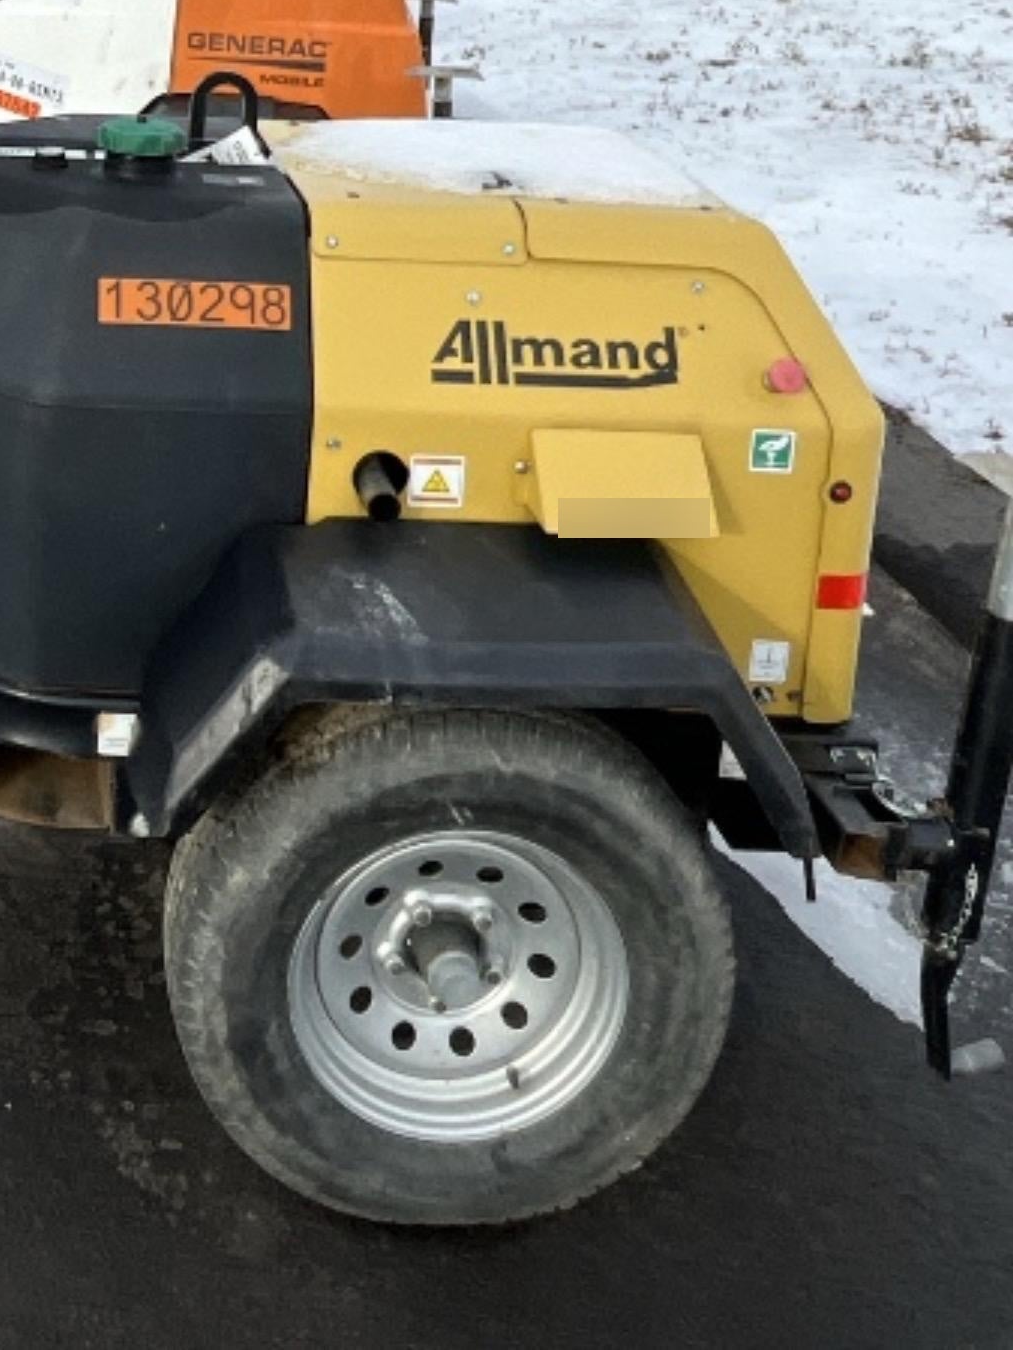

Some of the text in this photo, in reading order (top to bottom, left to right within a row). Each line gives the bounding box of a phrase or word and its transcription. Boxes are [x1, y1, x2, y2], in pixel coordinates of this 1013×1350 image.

[187, 32, 327, 59] GENERAC
[106, 281, 286, 326] 130298
[431, 318, 678, 386] Allmand
